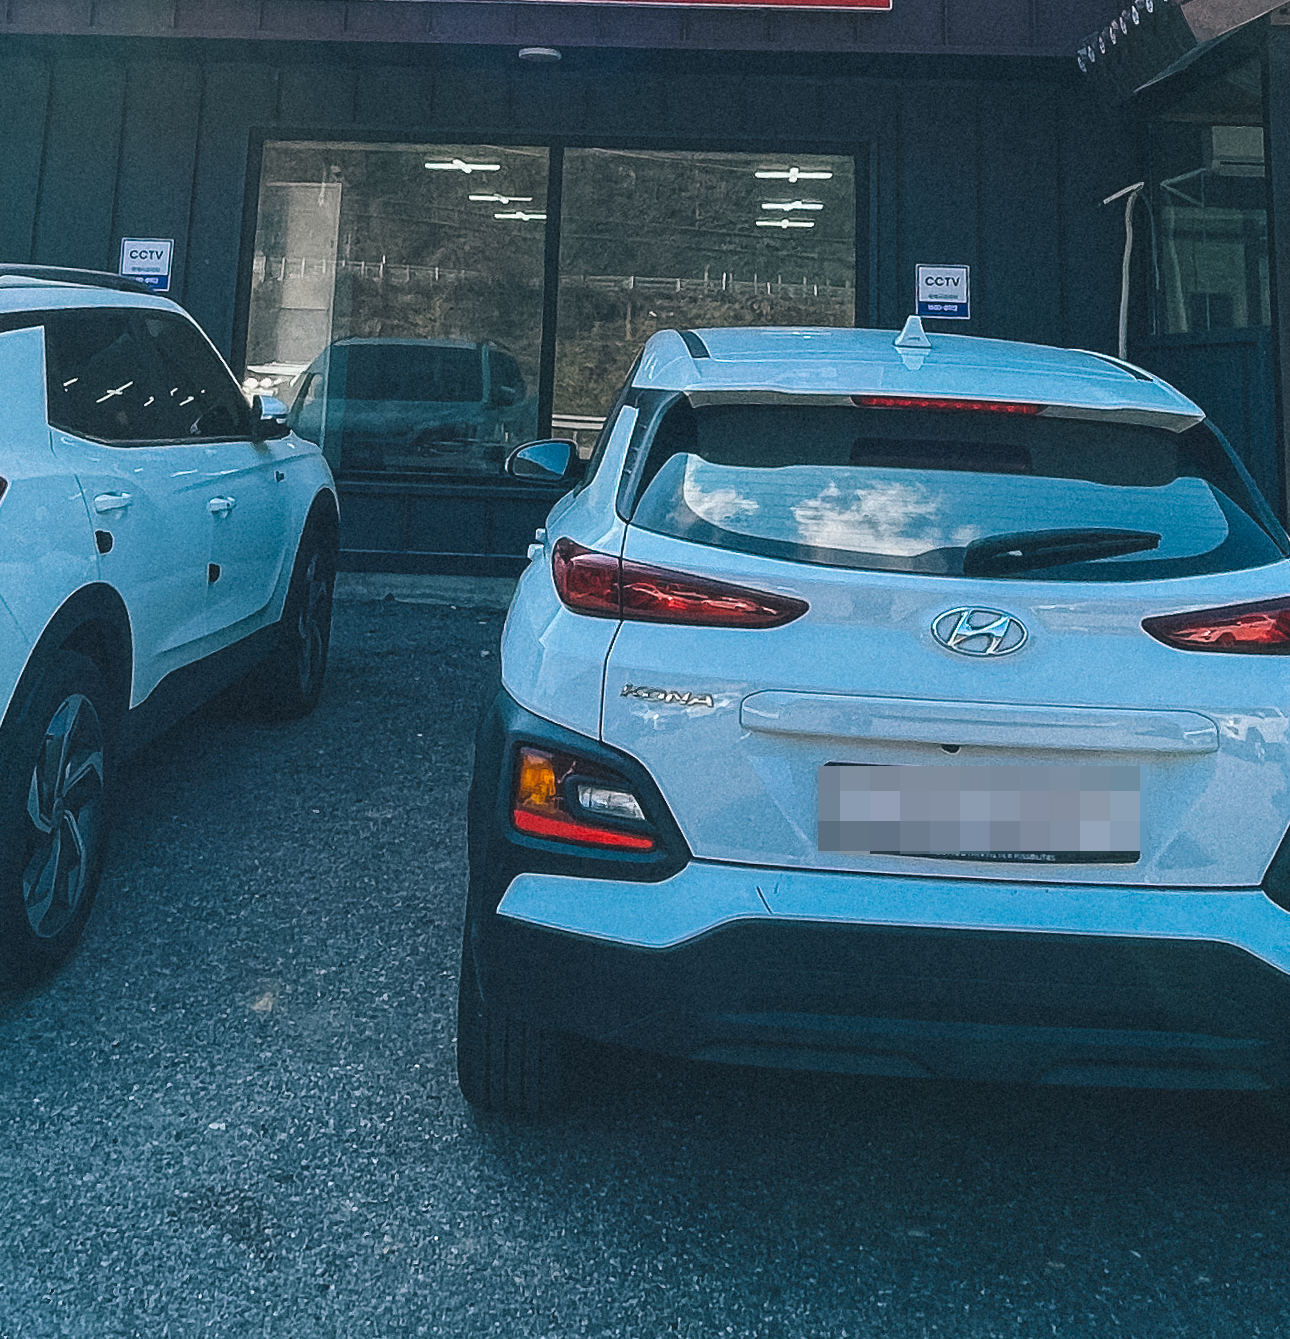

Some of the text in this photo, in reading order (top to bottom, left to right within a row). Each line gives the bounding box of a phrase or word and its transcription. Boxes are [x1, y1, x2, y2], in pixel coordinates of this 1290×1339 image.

[129, 249, 164, 261] CCTV
[924, 276, 961, 287] CCTV
[619, 683, 715, 708] KONA
